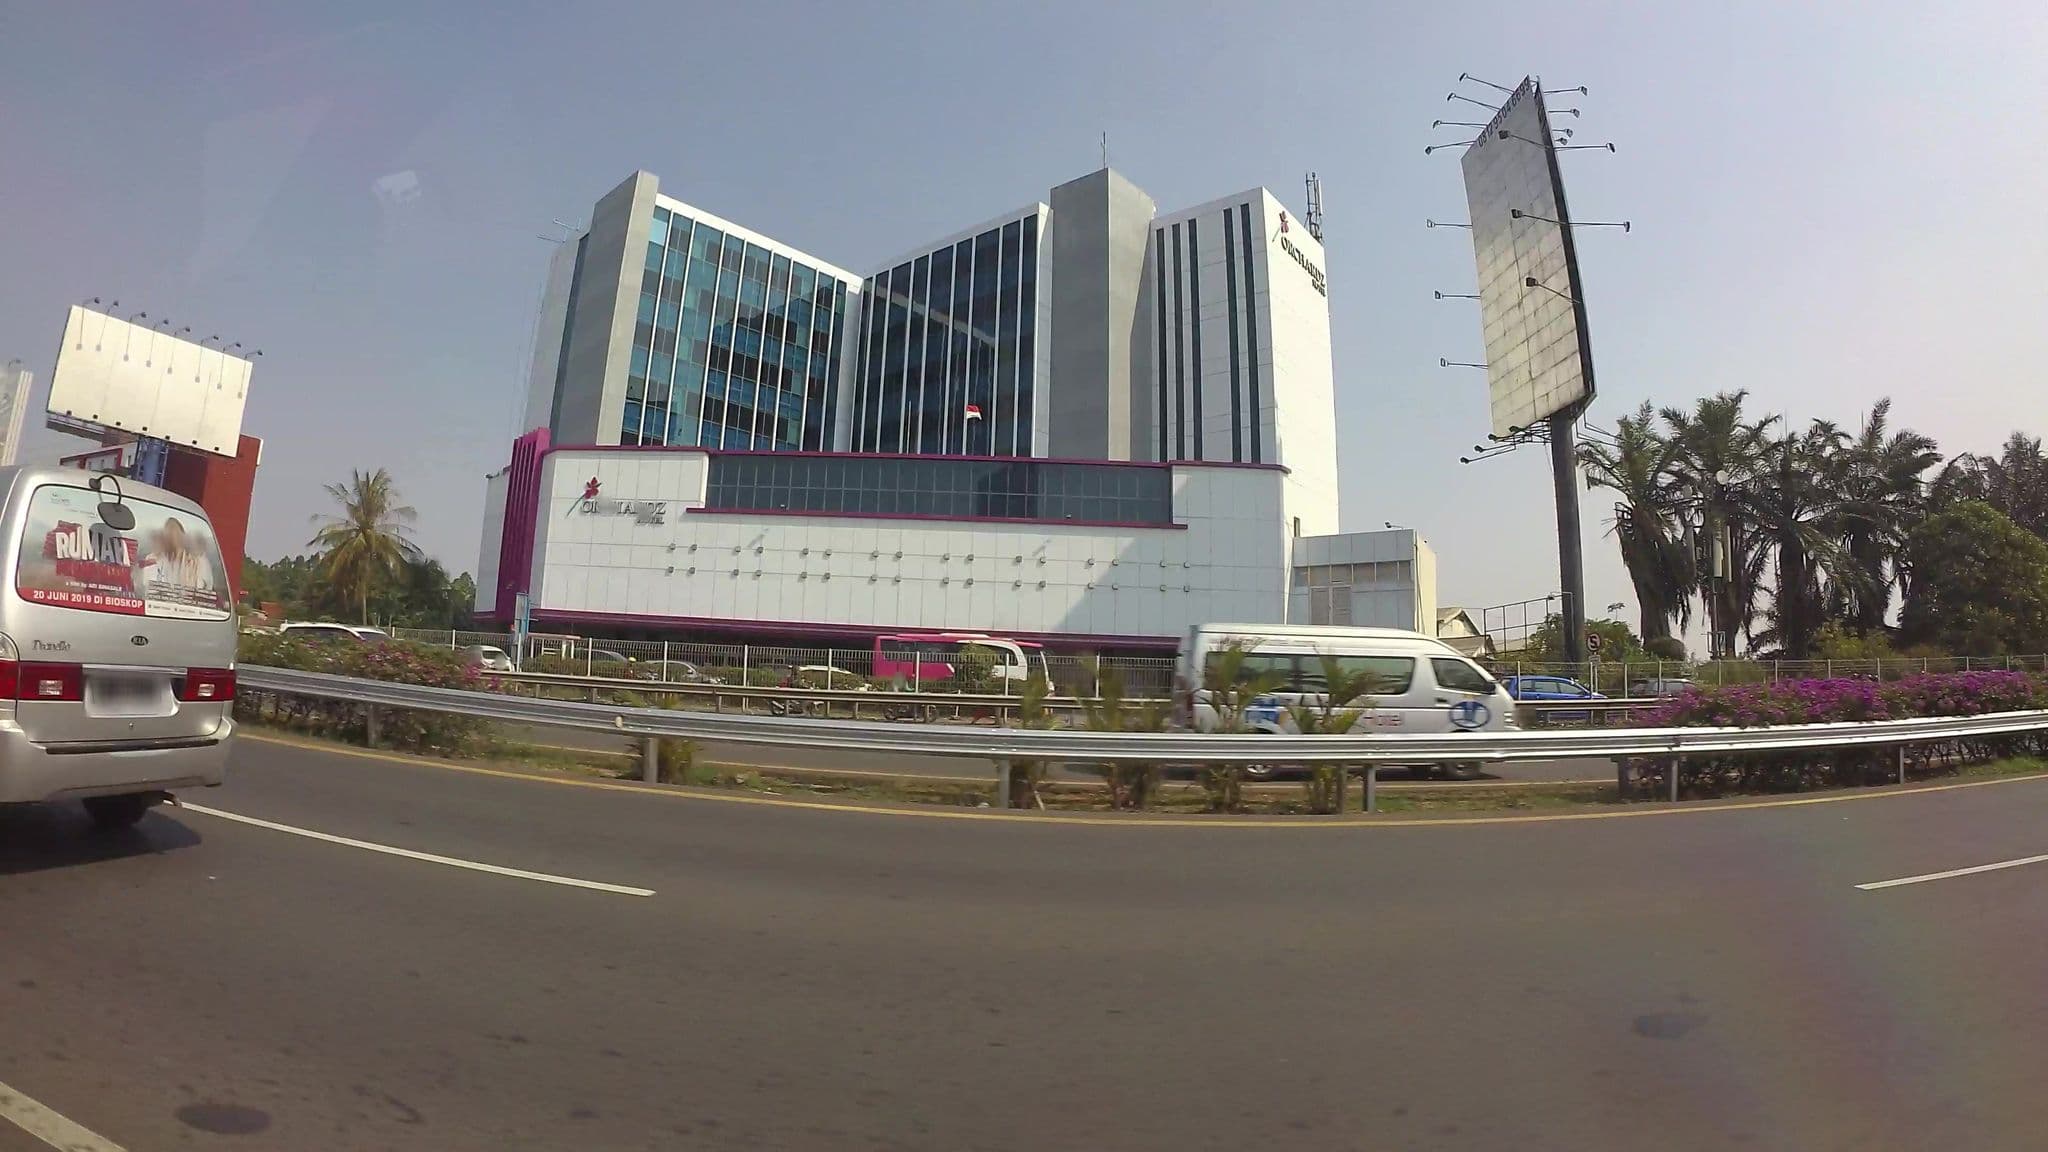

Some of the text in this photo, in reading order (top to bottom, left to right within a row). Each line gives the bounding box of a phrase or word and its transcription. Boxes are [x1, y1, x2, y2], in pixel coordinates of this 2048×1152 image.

[55, 524, 131, 567] RUMAH
[33, 590, 143, 608] 20 JUNI 2019 DI BIOSKOP
